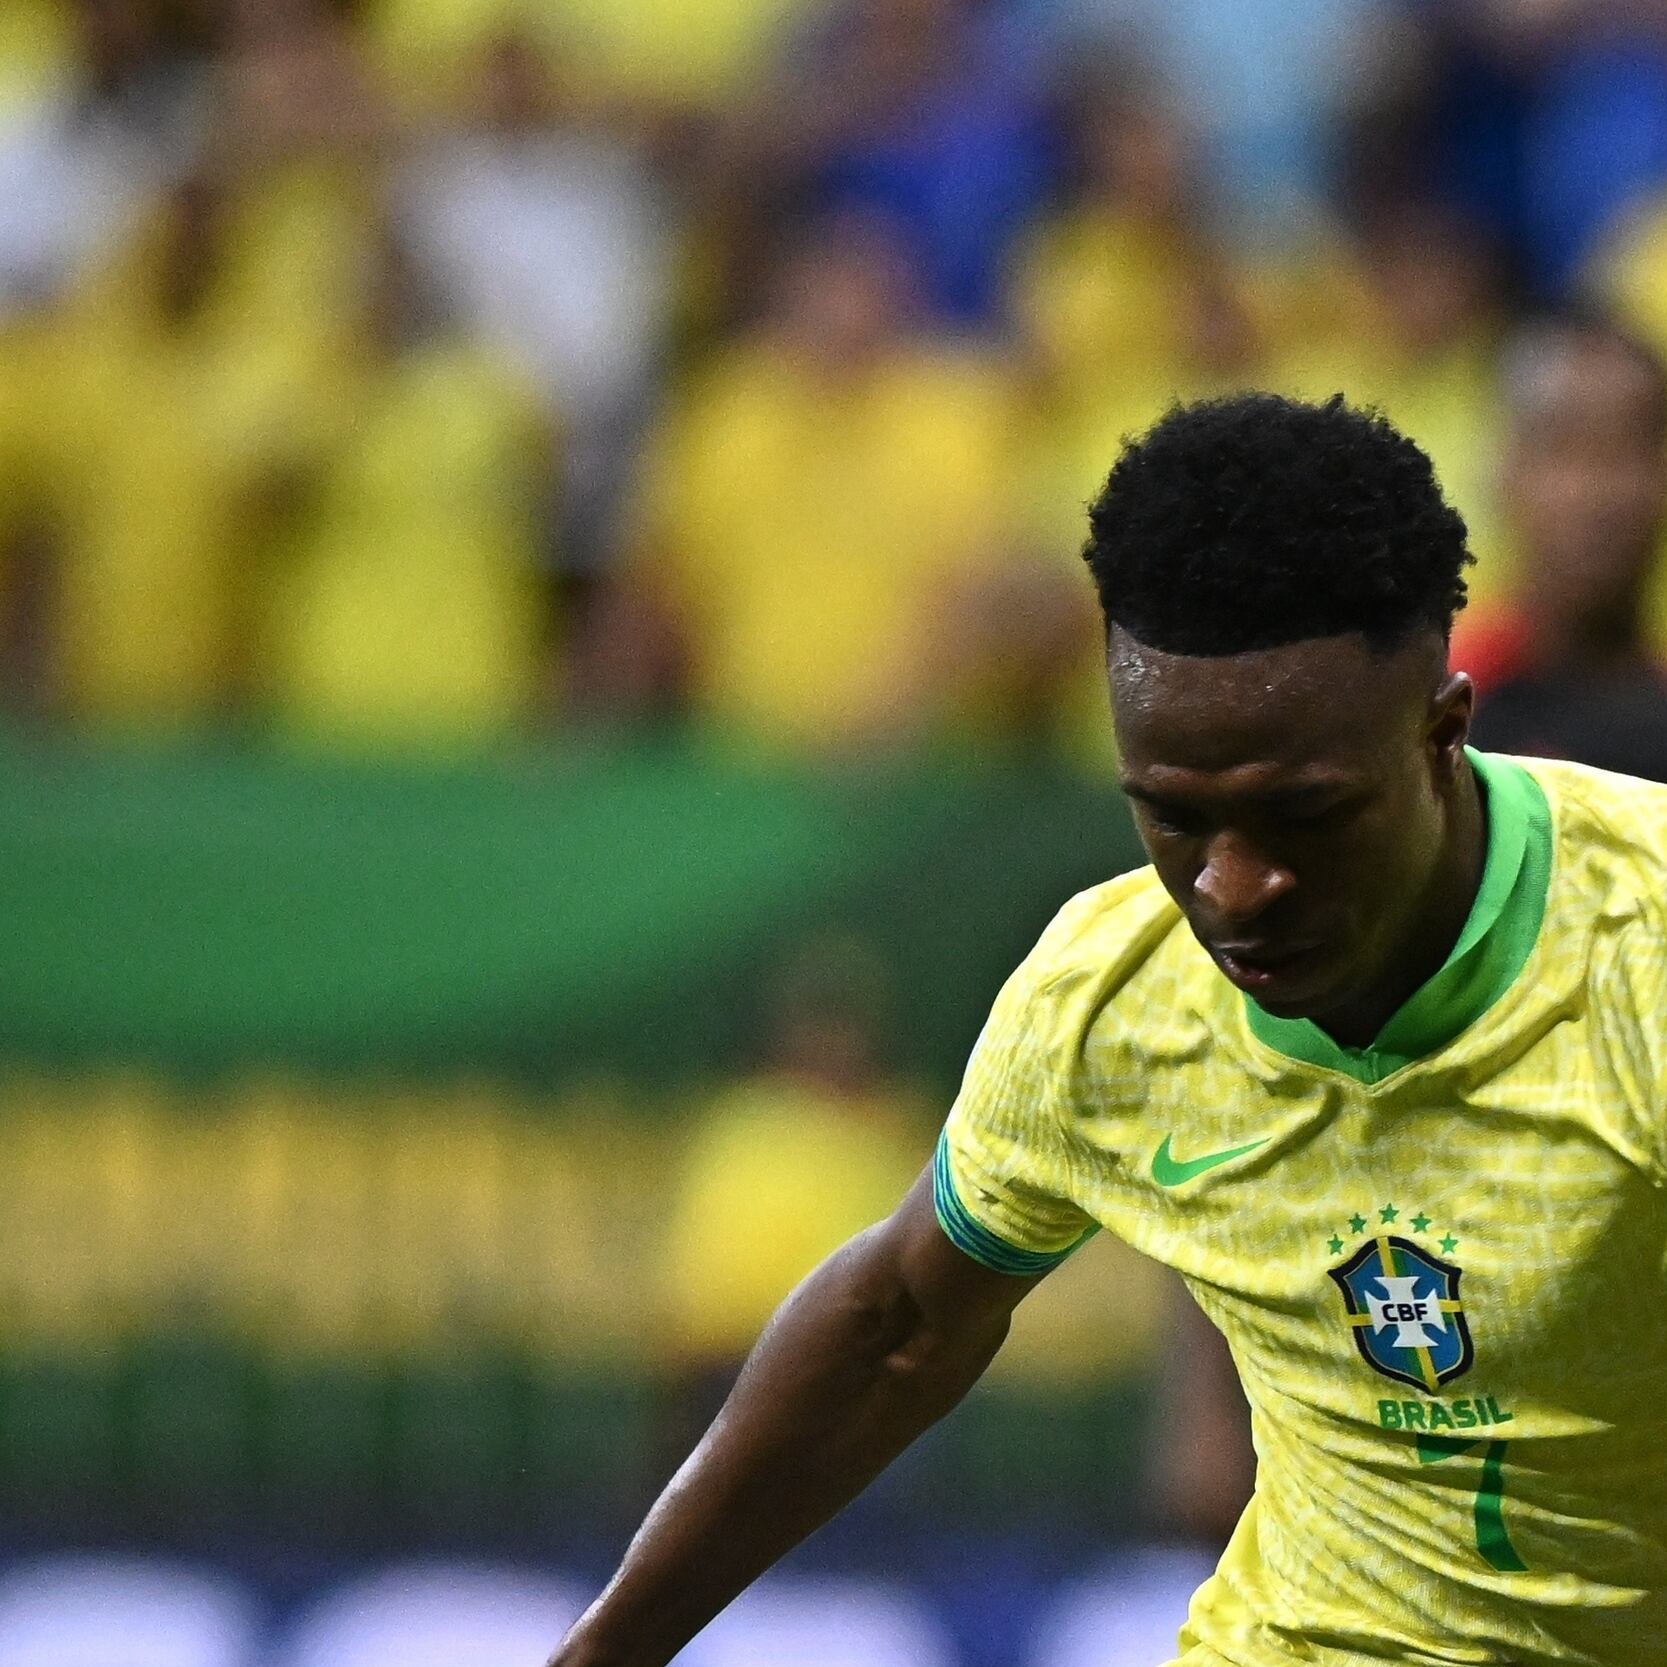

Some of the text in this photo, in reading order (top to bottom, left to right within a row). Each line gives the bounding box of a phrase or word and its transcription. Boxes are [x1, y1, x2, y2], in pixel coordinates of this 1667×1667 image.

[1381, 1302, 1429, 1323] CBF
[1378, 1397, 1514, 1431] BRASIL
[1416, 1433, 1530, 1573] 7
